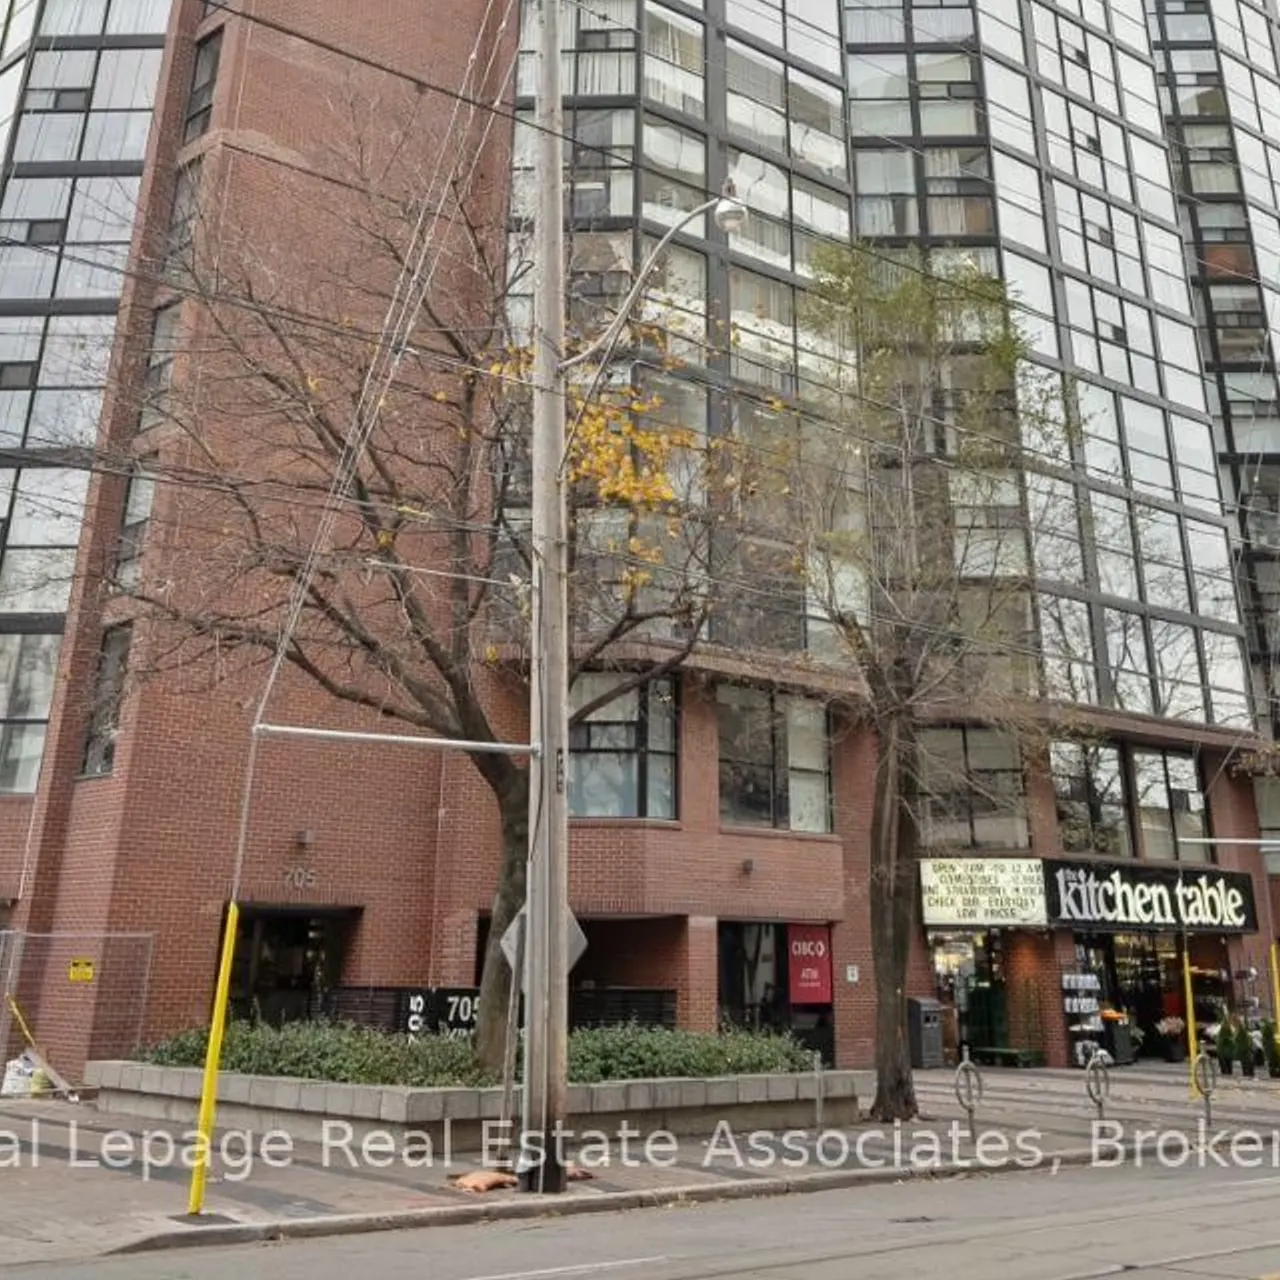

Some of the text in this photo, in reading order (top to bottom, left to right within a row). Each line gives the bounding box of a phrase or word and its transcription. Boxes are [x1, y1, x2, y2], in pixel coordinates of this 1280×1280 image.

[282, 868, 317, 889] 705
[1055, 867, 1246, 927] kitchen table
[791, 941, 816, 956] CIBC
